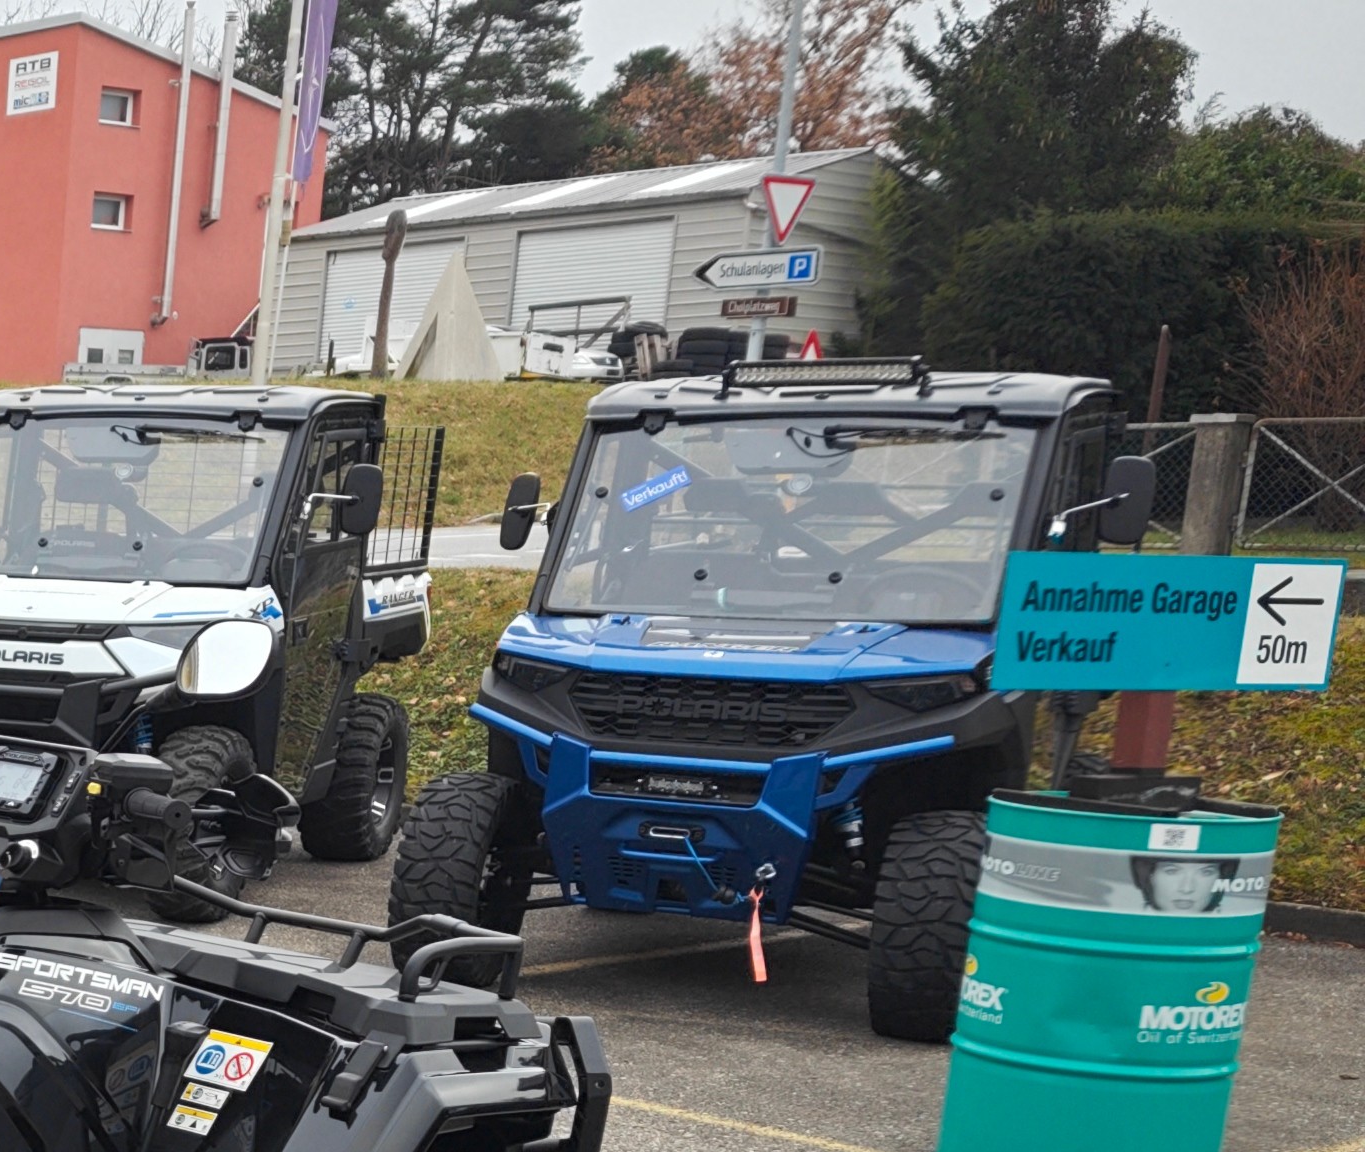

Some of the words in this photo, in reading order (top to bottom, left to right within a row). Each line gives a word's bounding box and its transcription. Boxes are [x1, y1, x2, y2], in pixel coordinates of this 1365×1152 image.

[16, 58, 51, 74] ATB
[719, 260, 786, 279] Schulanlagen
[1021, 580, 1144, 613] Annahme
[1152, 582, 1238, 621] Garage
[1017, 630, 1117, 663] Verkauf
[1255, 634, 1308, 664] 50m
[616, 696, 787, 722] POLARIS
[19, 978, 112, 1013] 570
[960, 976, 1005, 1011] OREX
[1136, 1030, 1161, 1044] Oil
[1166, 1030, 1183, 1045] of
